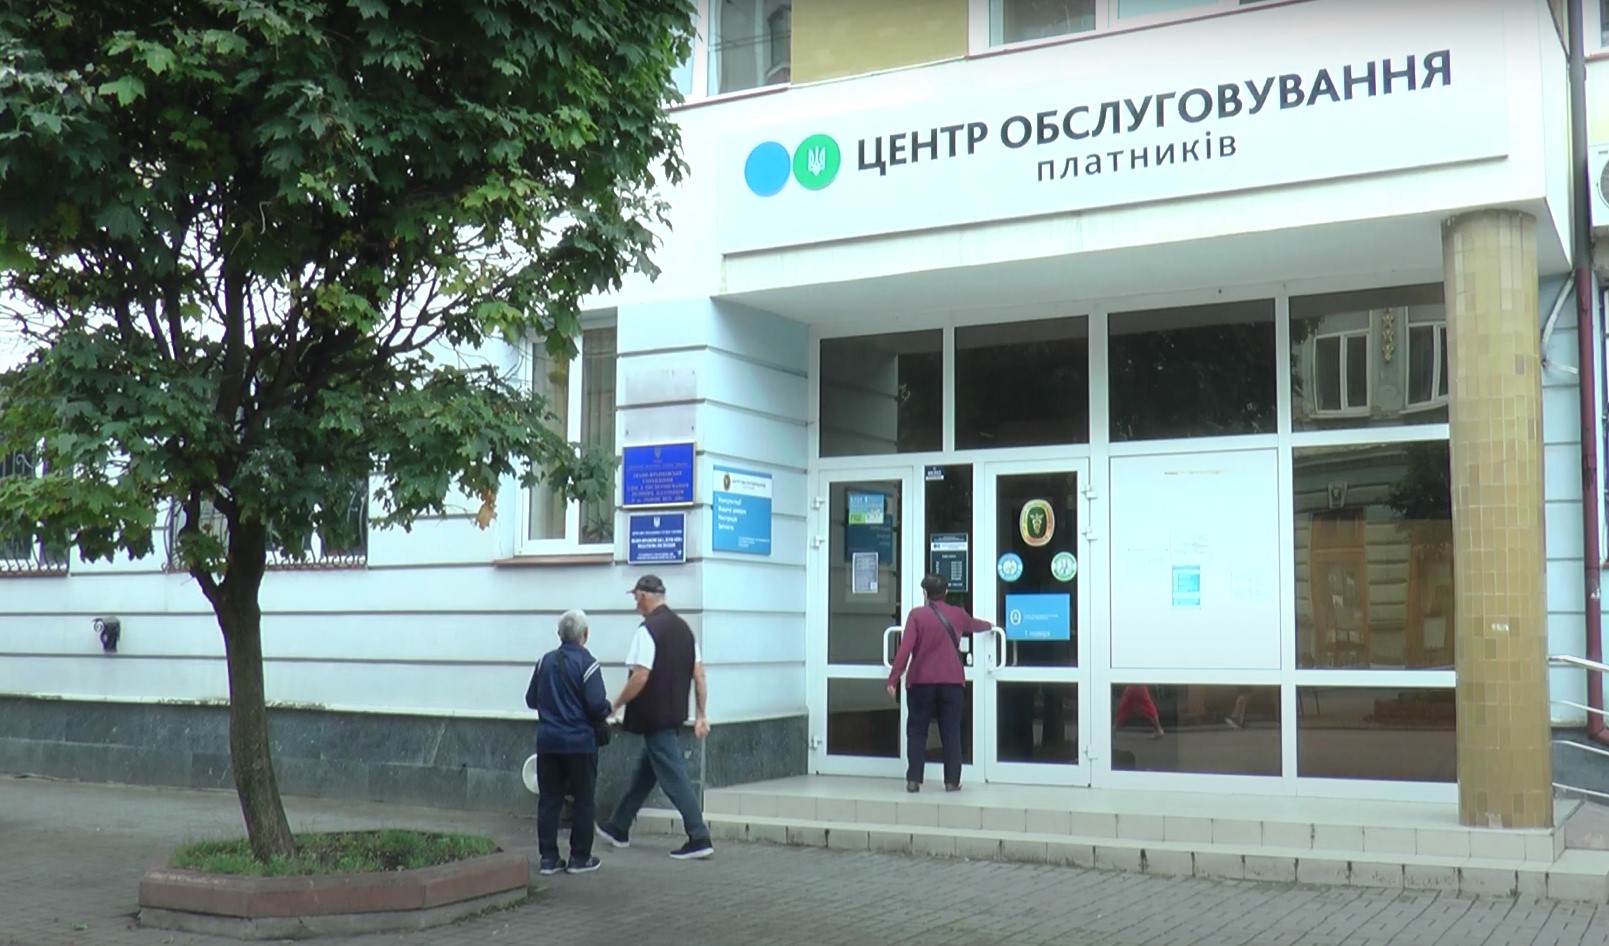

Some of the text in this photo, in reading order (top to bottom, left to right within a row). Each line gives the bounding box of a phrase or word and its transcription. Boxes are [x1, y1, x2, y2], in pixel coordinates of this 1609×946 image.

[858, 49, 1451, 176] ЦЕНТР ОБСЛУГОВУВАННЯ
[1038, 131, 1237, 182] платників
